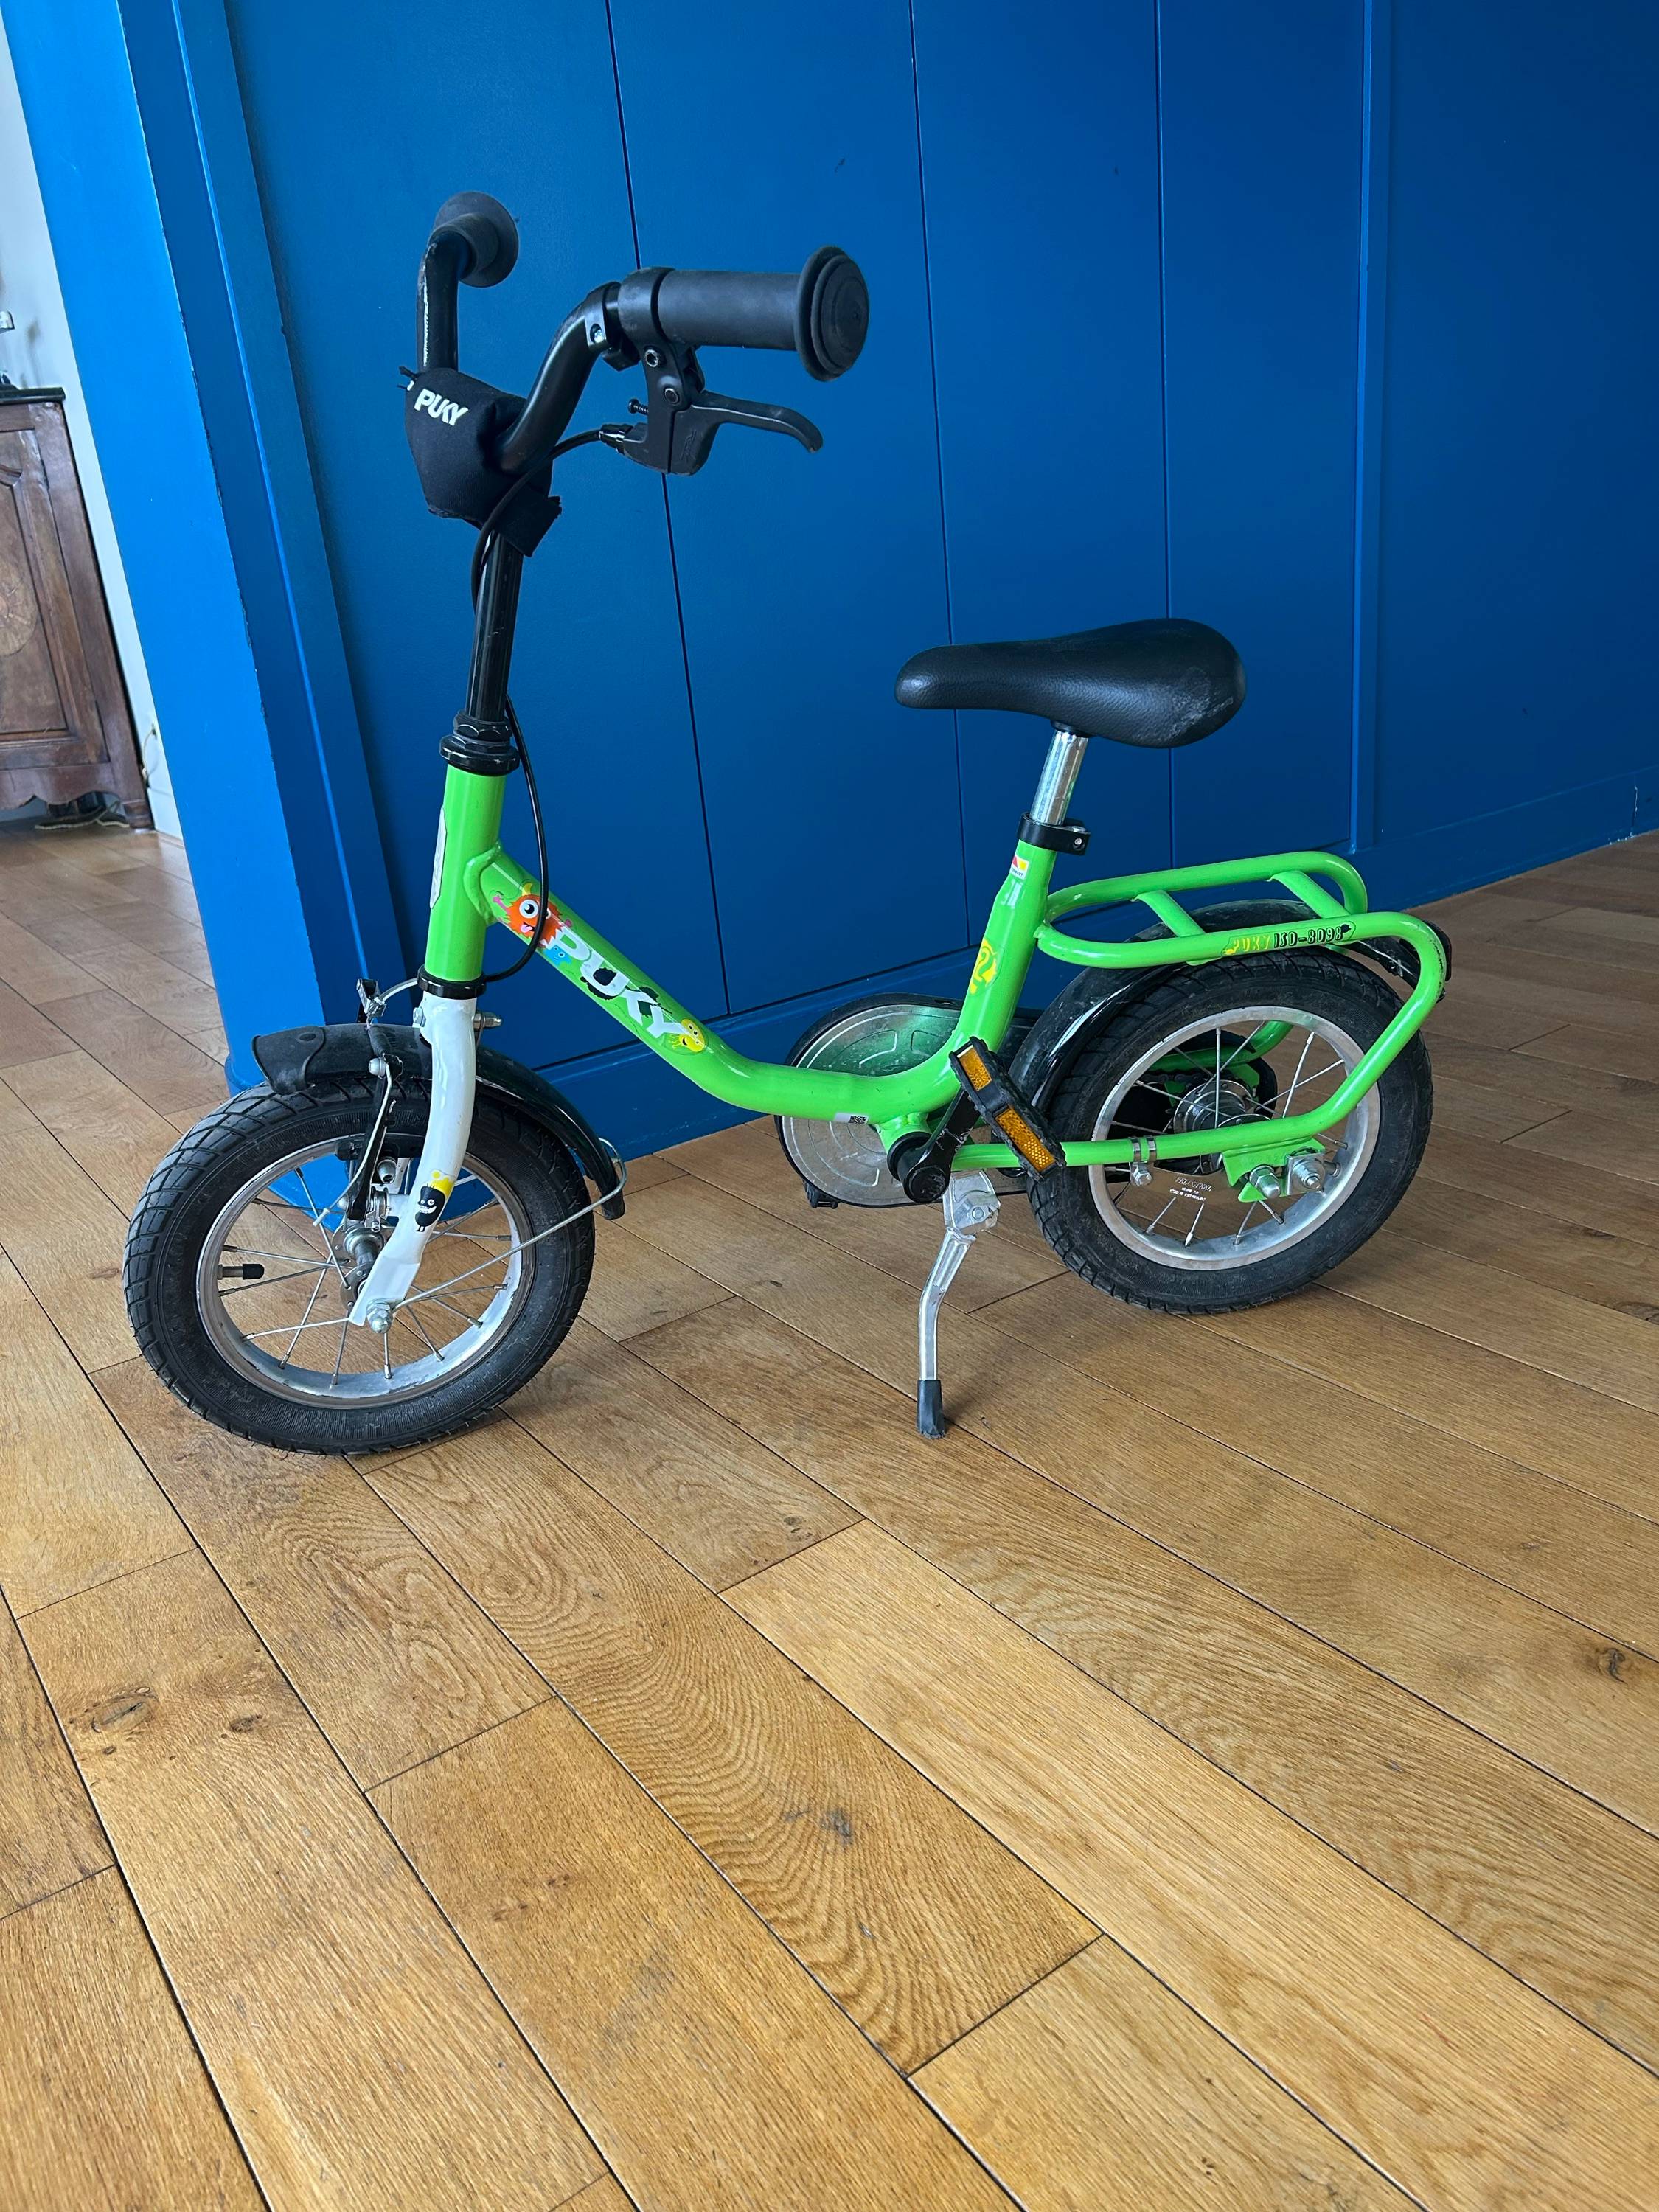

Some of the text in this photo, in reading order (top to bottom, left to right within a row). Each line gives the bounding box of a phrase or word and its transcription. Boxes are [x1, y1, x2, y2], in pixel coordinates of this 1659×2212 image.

[414, 388, 469, 426] PUKY
[1273, 925, 1343, 949] ISO-8098
[544, 925, 689, 1039] PUKY
